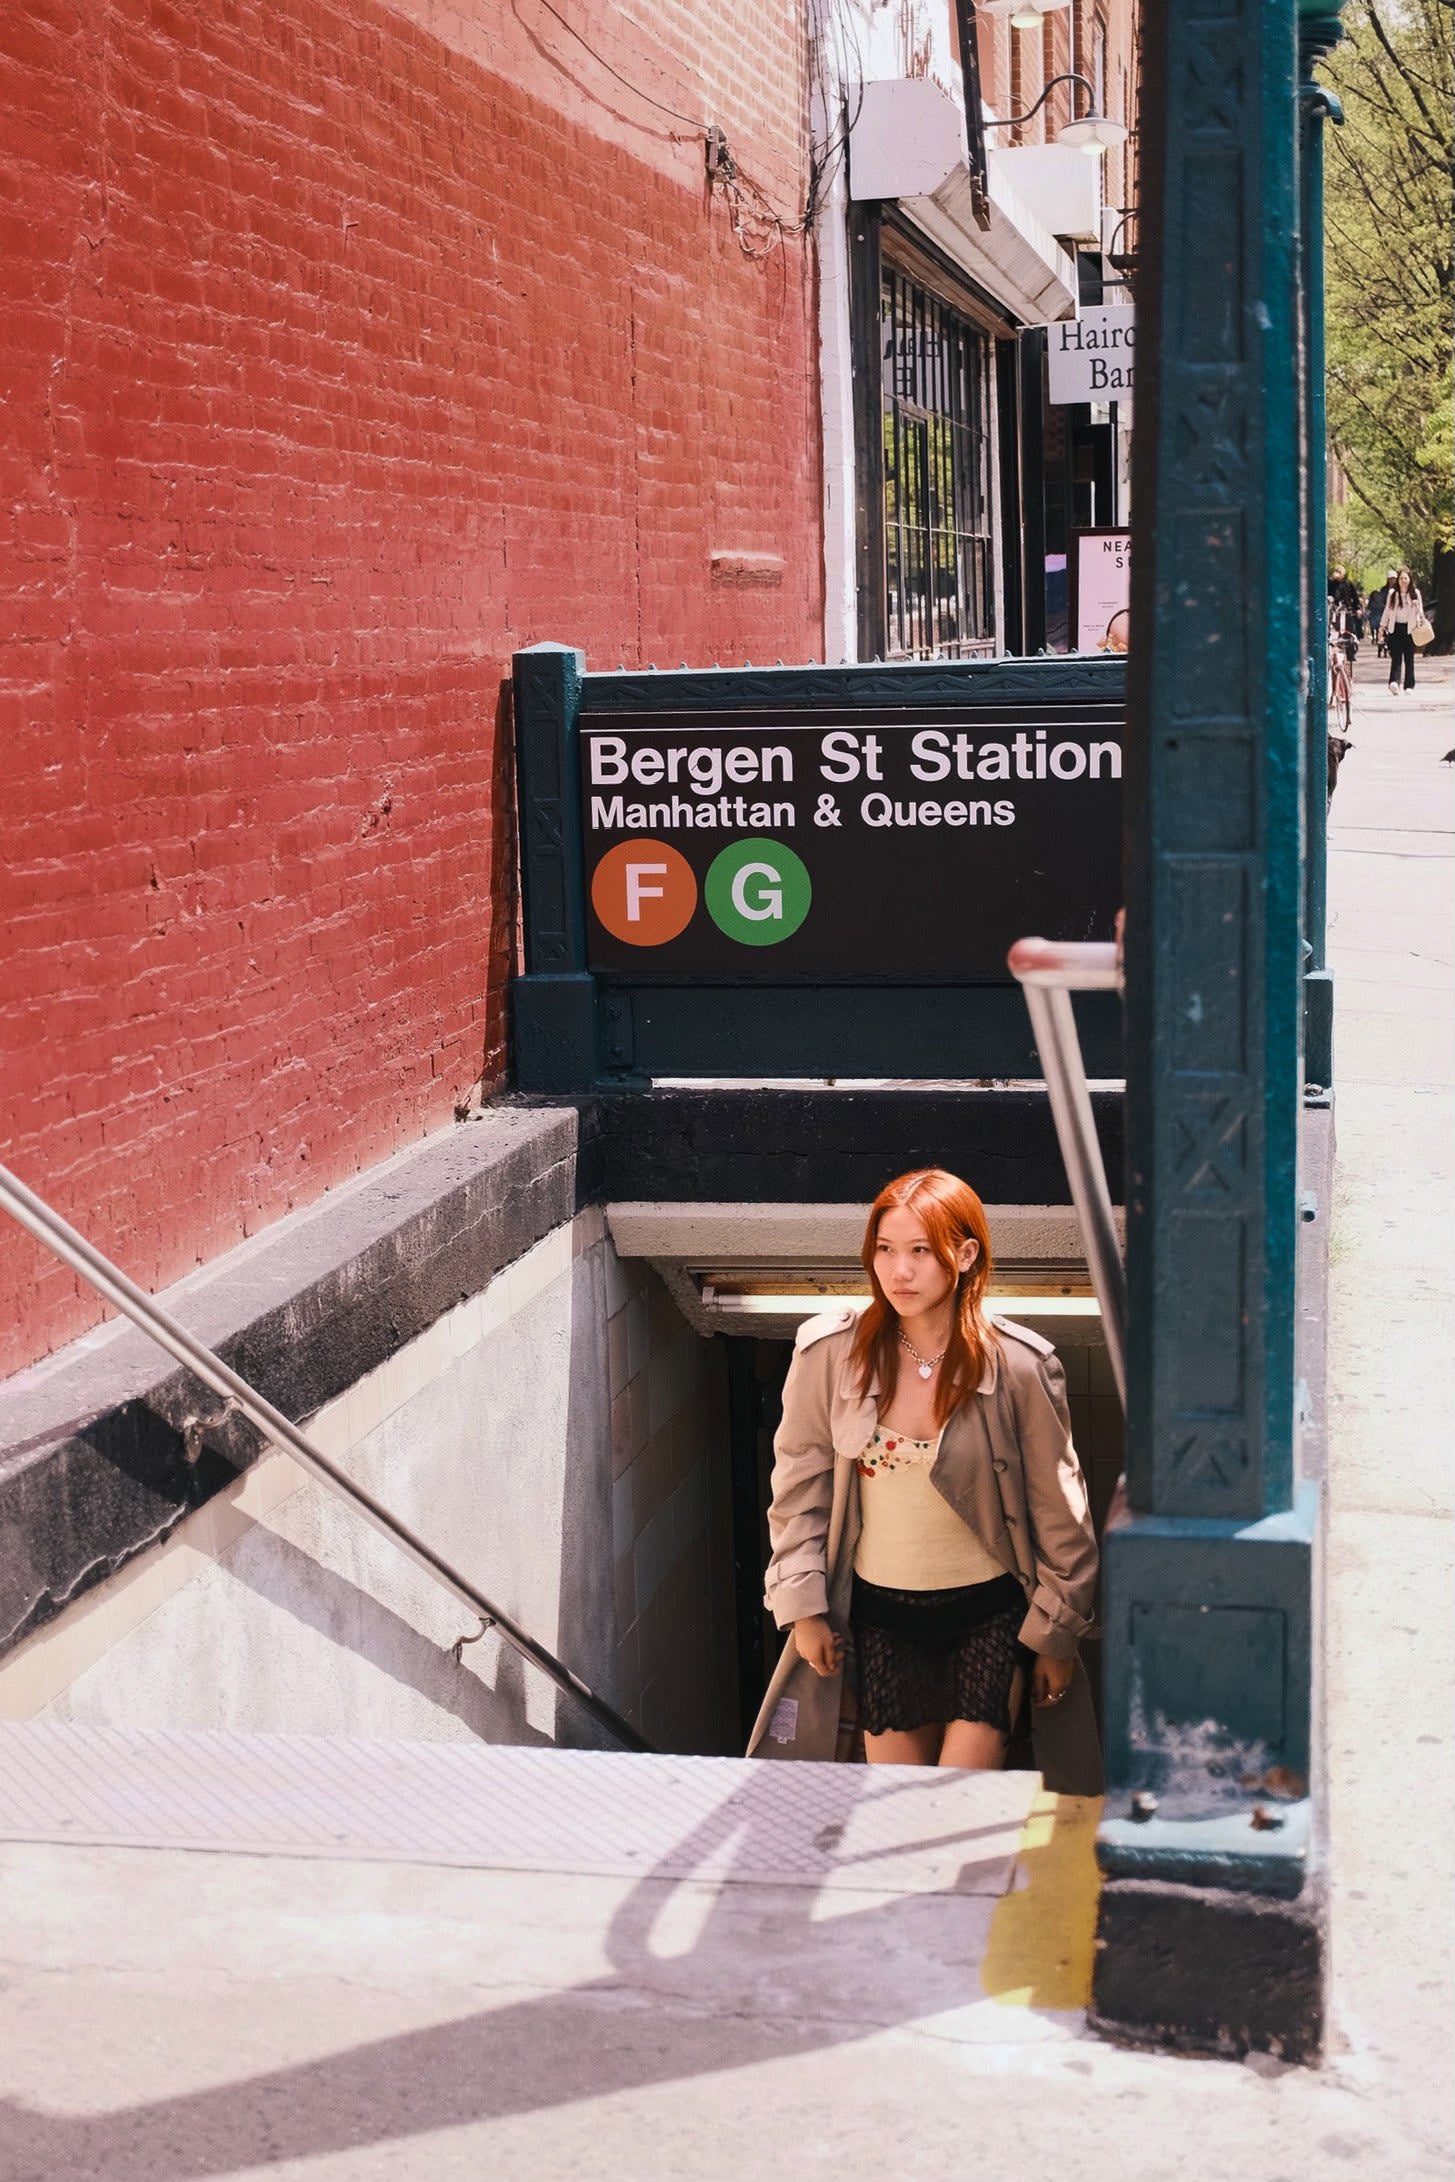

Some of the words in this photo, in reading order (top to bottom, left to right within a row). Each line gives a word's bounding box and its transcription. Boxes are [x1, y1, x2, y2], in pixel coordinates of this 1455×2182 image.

[590, 736, 793, 796] Bergen
[820, 731, 884, 783] St
[910, 730, 1122, 782] Station
[591, 795, 796, 829] Manhattan
[813, 793, 842, 827] &
[860, 792, 1016, 828] Queens
[625, 863, 667, 922] F
[731, 862, 783, 921] G
